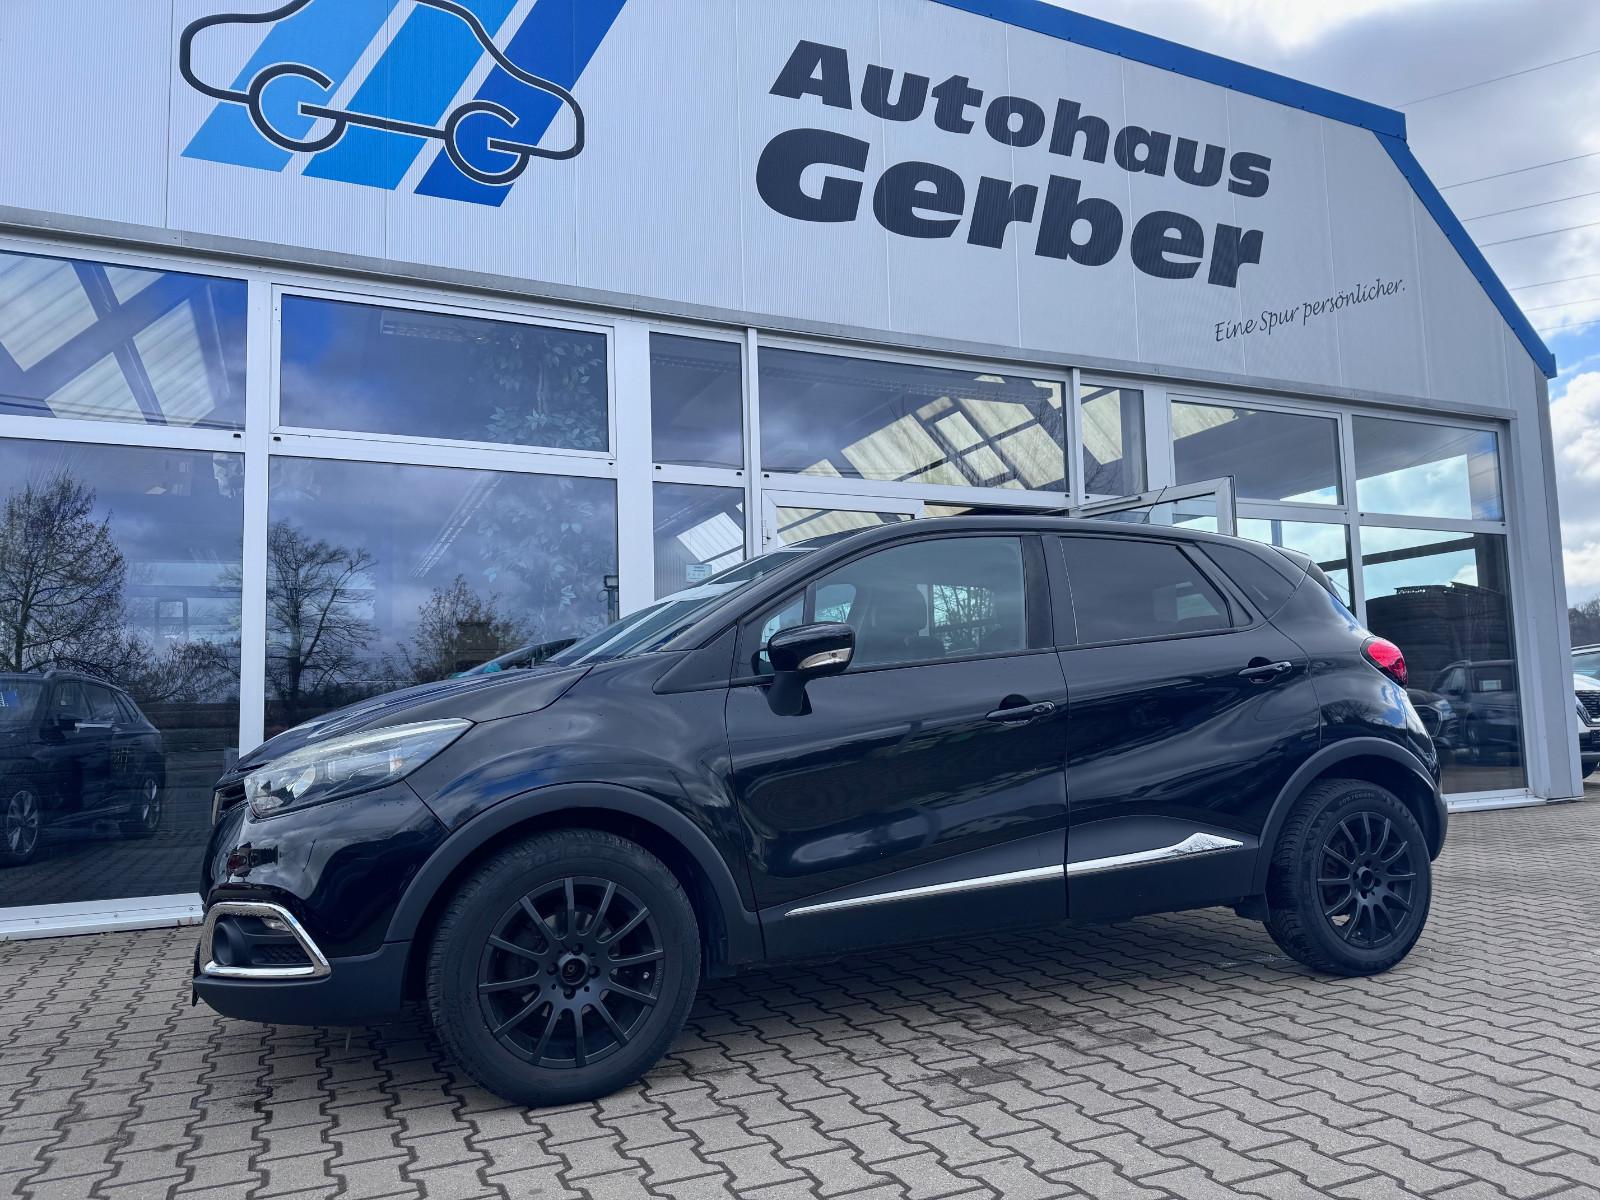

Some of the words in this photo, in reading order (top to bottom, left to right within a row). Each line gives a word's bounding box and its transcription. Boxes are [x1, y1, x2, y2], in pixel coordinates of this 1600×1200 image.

[768, 39, 1272, 198] Autohaus
[755, 127, 1264, 289] Gerber
[1214, 319, 1258, 342] Eine
[1259, 306, 1301, 335] Spur
[1302, 278, 1406, 326] persönlicher.
